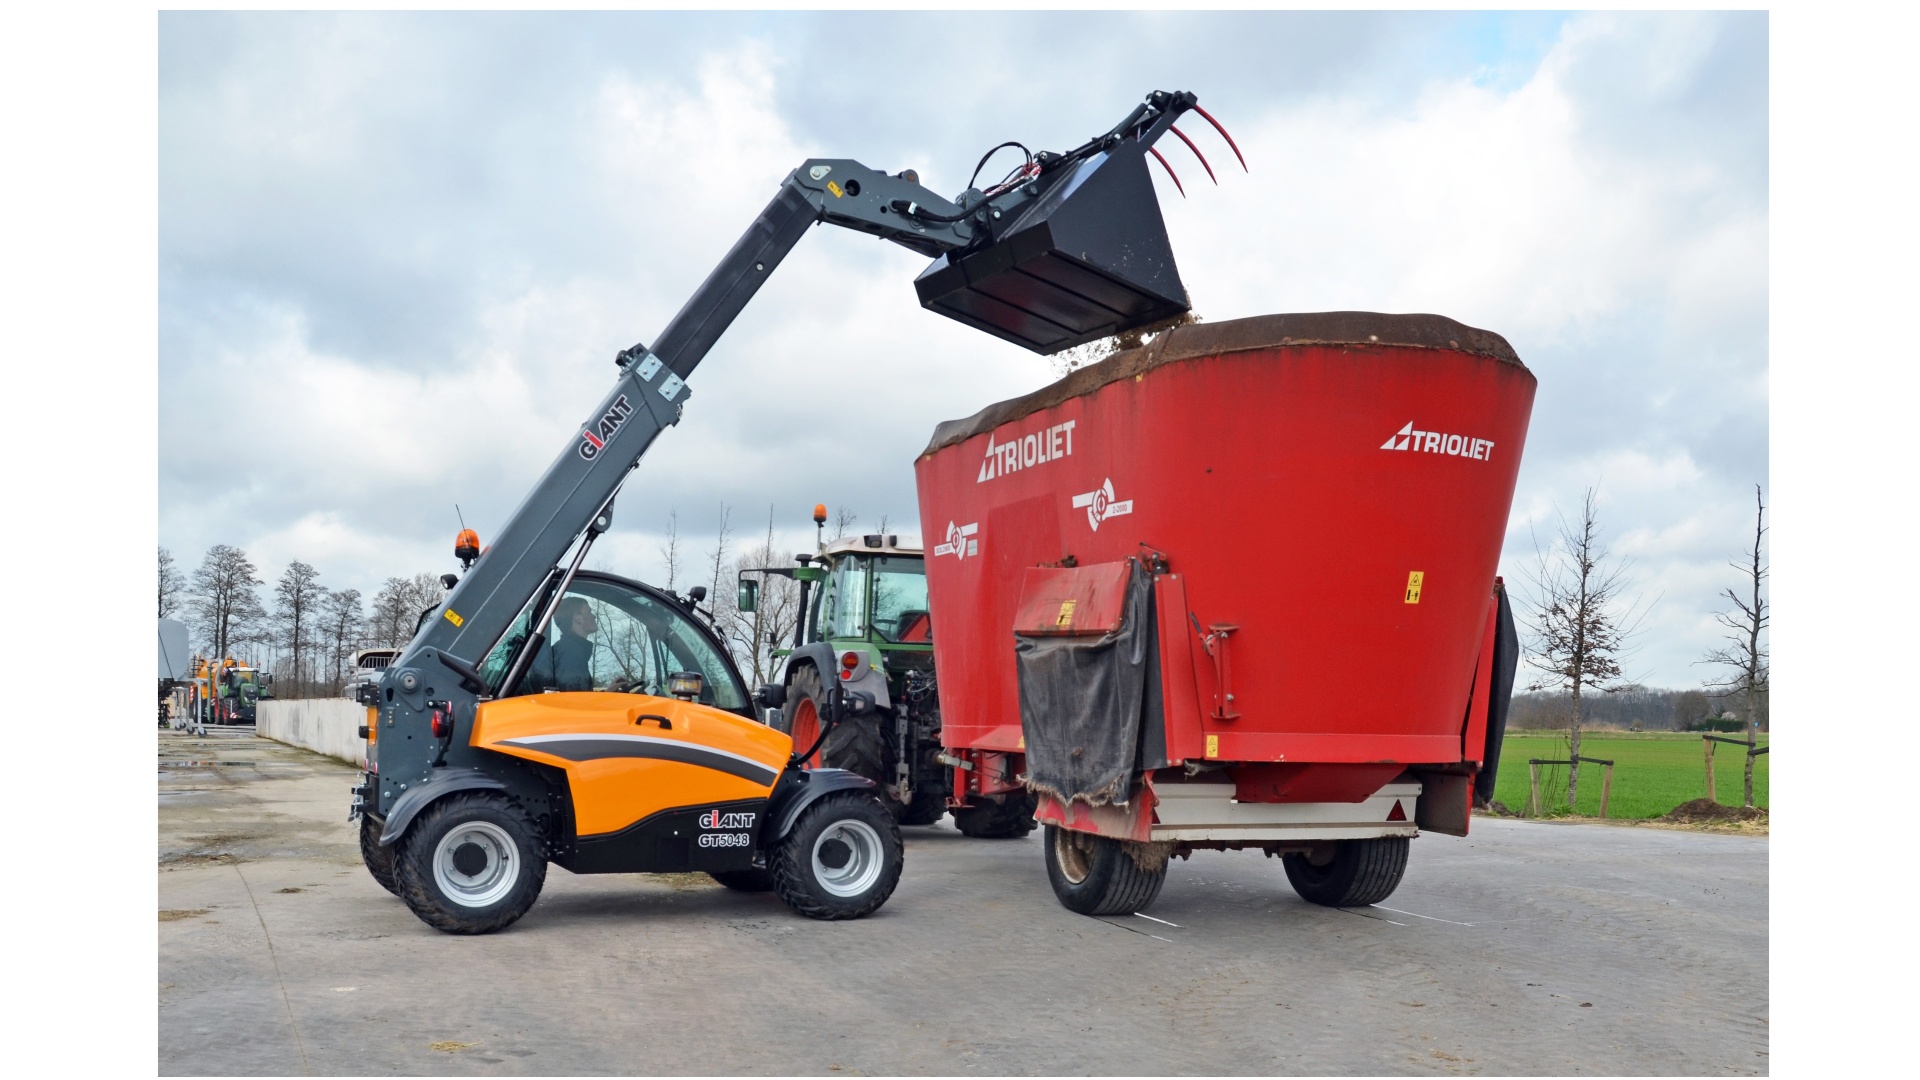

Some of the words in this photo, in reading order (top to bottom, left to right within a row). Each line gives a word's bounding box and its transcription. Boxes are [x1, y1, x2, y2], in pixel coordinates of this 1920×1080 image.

[994, 419, 1076, 477] TRIOLIET
[1412, 430, 1495, 461] TRIOLIET
[698, 833, 750, 848] GT5048
